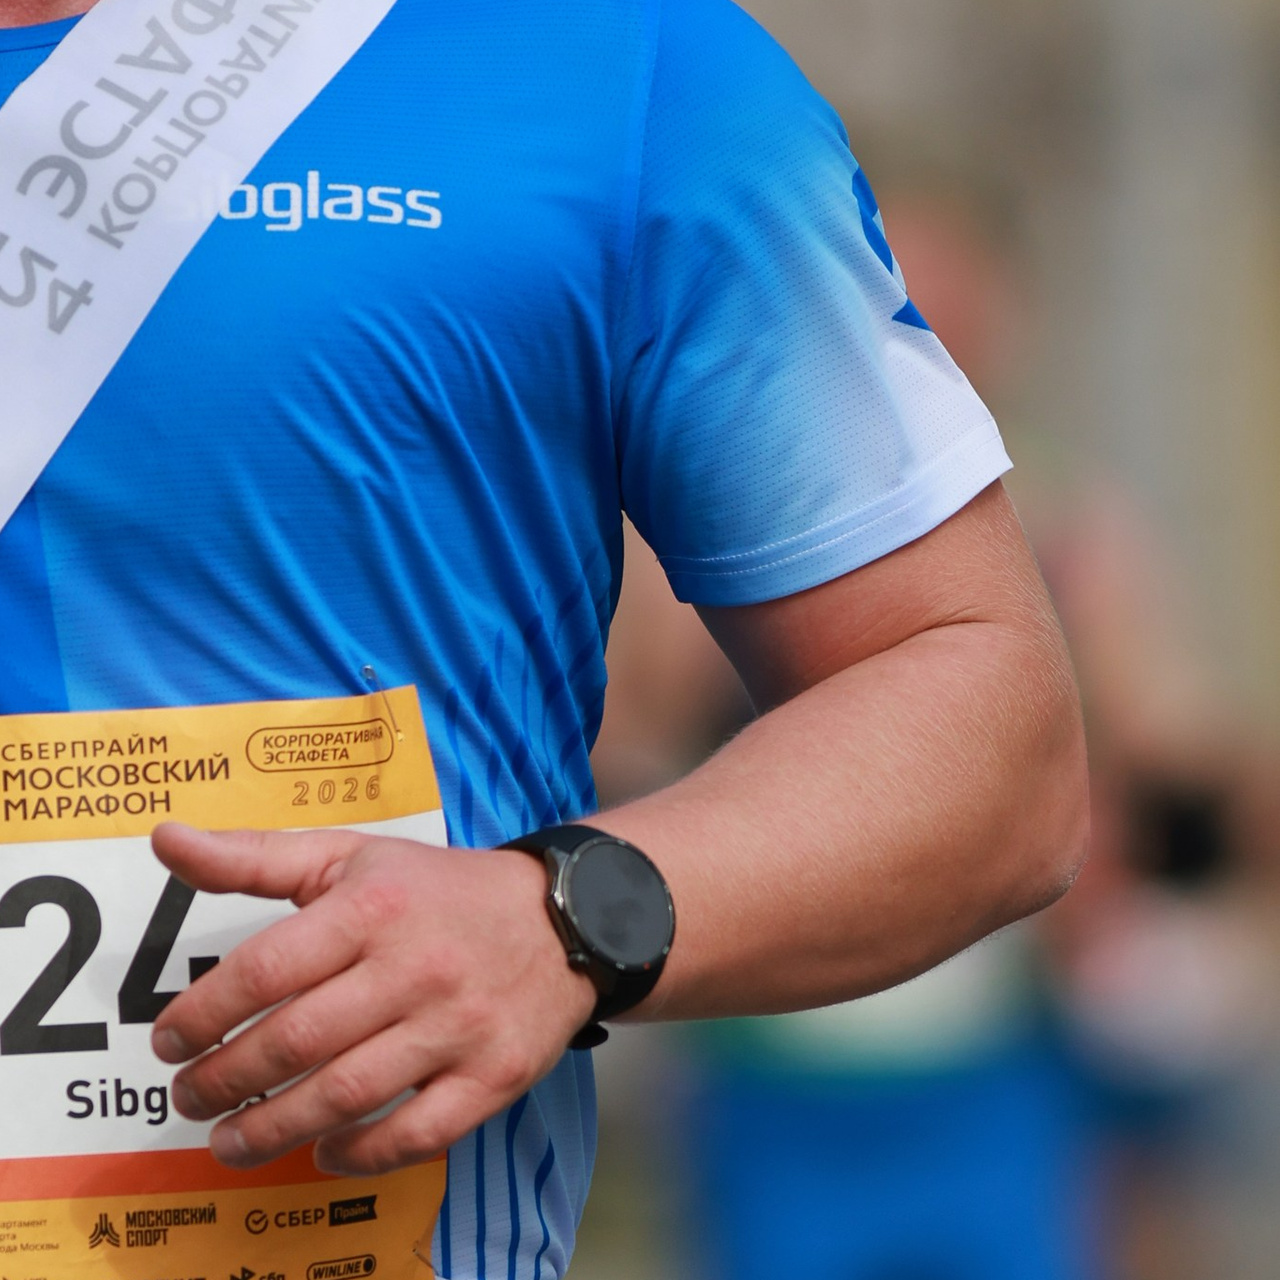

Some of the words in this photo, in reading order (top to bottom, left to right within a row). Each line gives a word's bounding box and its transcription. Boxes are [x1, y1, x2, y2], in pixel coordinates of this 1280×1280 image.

[218, 170, 442, 232] bglass
[1, 735, 169, 763] СБЕРПРАЙМ
[262, 725, 384, 750] КОРПОРАТИВНАЯ
[263, 746, 351, 765] ЭСТАФЕТА
[2, 752, 231, 793] МОСКОВСКИЙ
[291, 775, 382, 806] 2026
[3, 790, 171, 822] МАРАФОН
[66, 1079, 169, 1125] Sibg
[125, 1202, 217, 1228] МОСКОВСКИЙ
[274, 1208, 325, 1228] СБЕР
[333, 1203, 370, 1221] Прайм
[126, 1228, 169, 1247] СПОРТ
[312, 1260, 362, 1280] WINLINE
